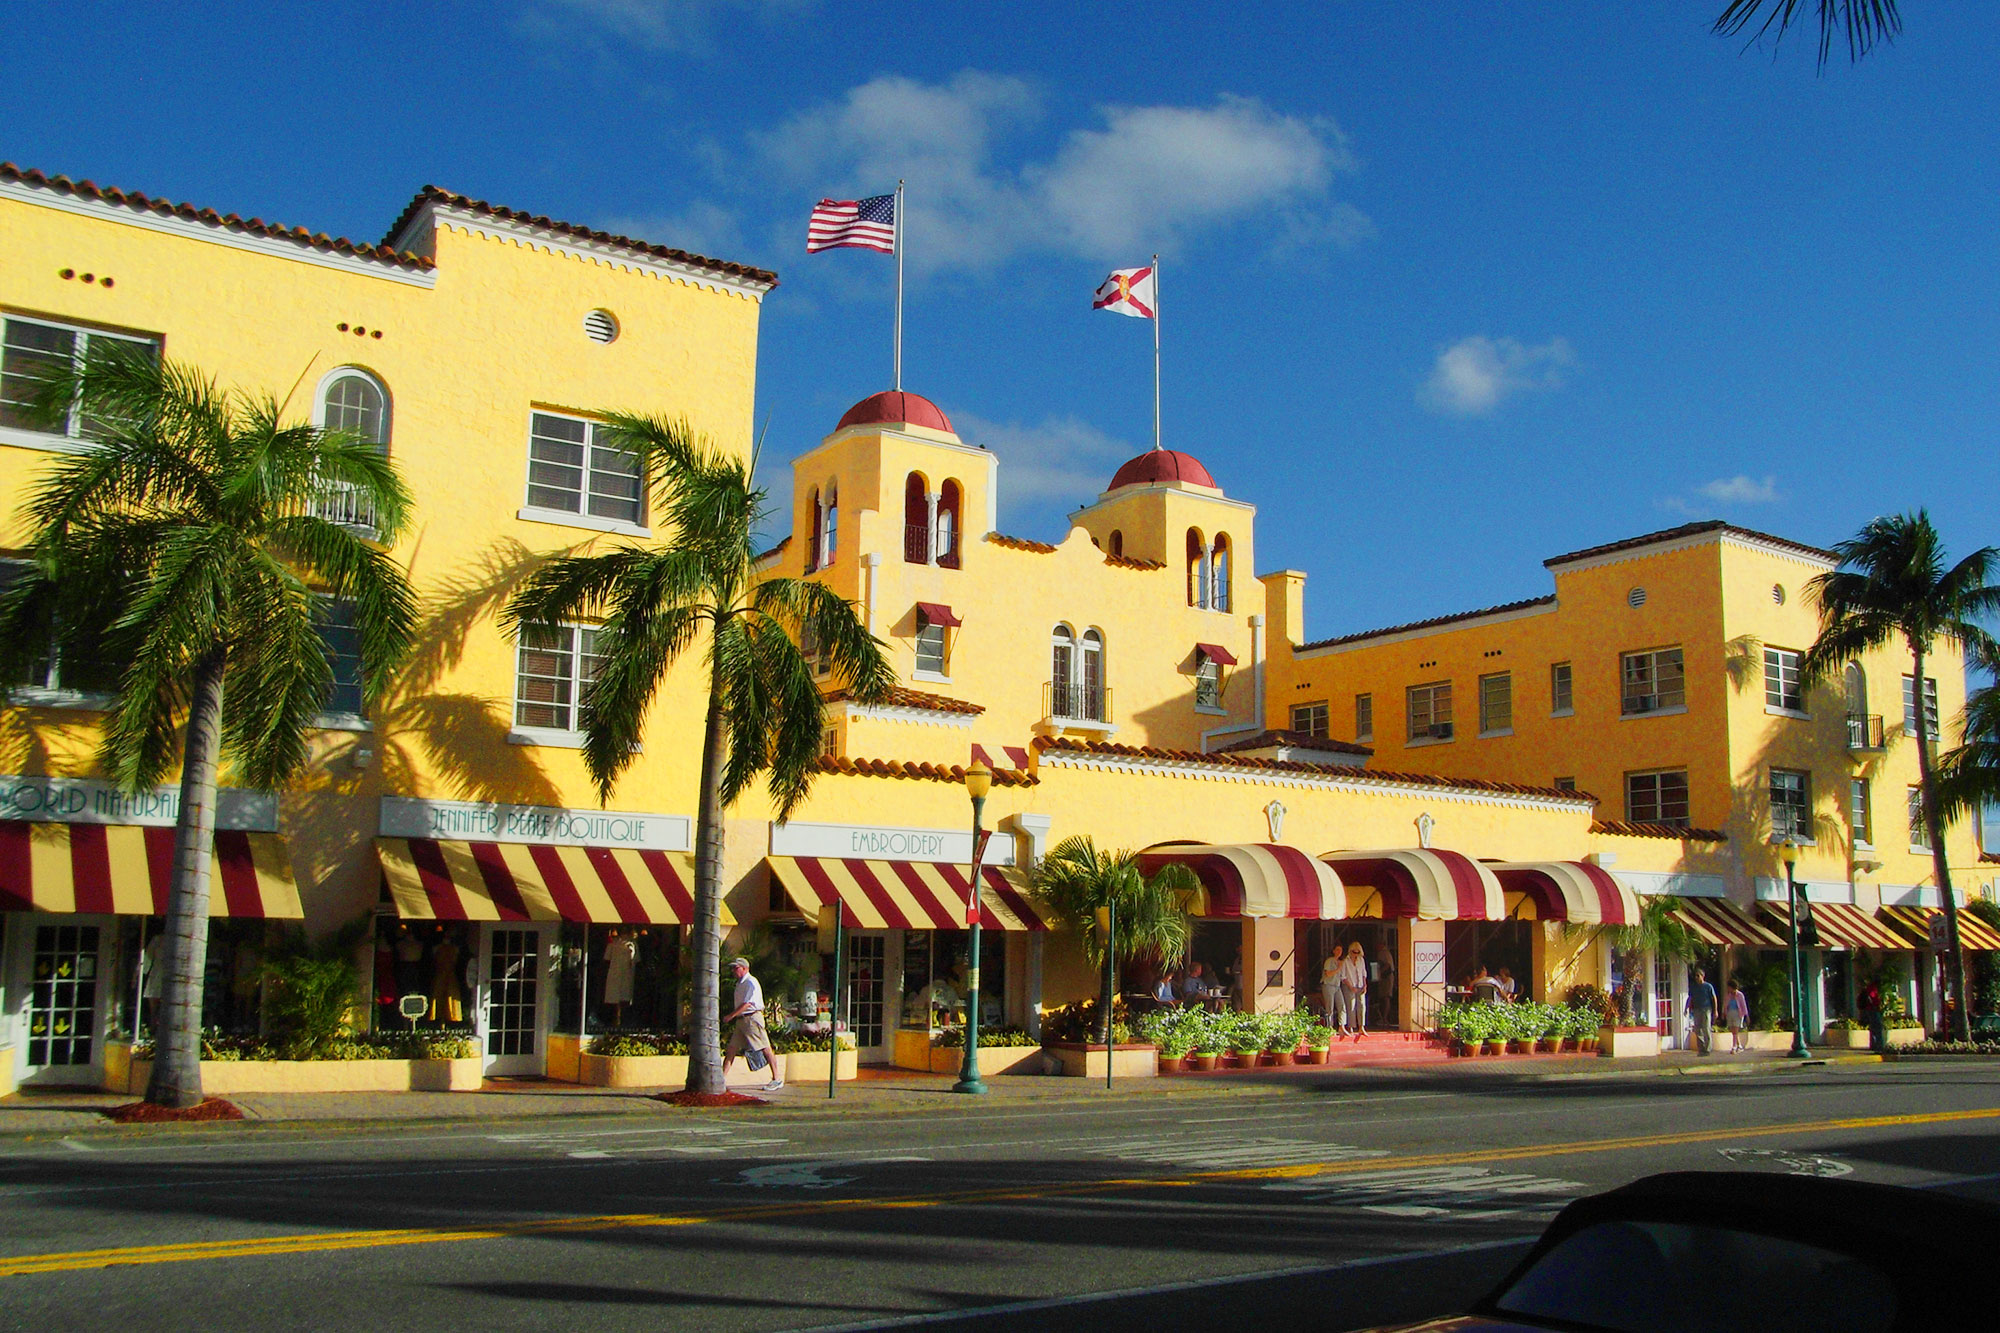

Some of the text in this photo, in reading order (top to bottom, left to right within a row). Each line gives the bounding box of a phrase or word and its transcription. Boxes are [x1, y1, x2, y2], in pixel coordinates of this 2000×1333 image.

[432, 808, 645, 841] JENNIFER REALE BOUTIQUE
[851, 831, 944, 855] EMBROIDERY
